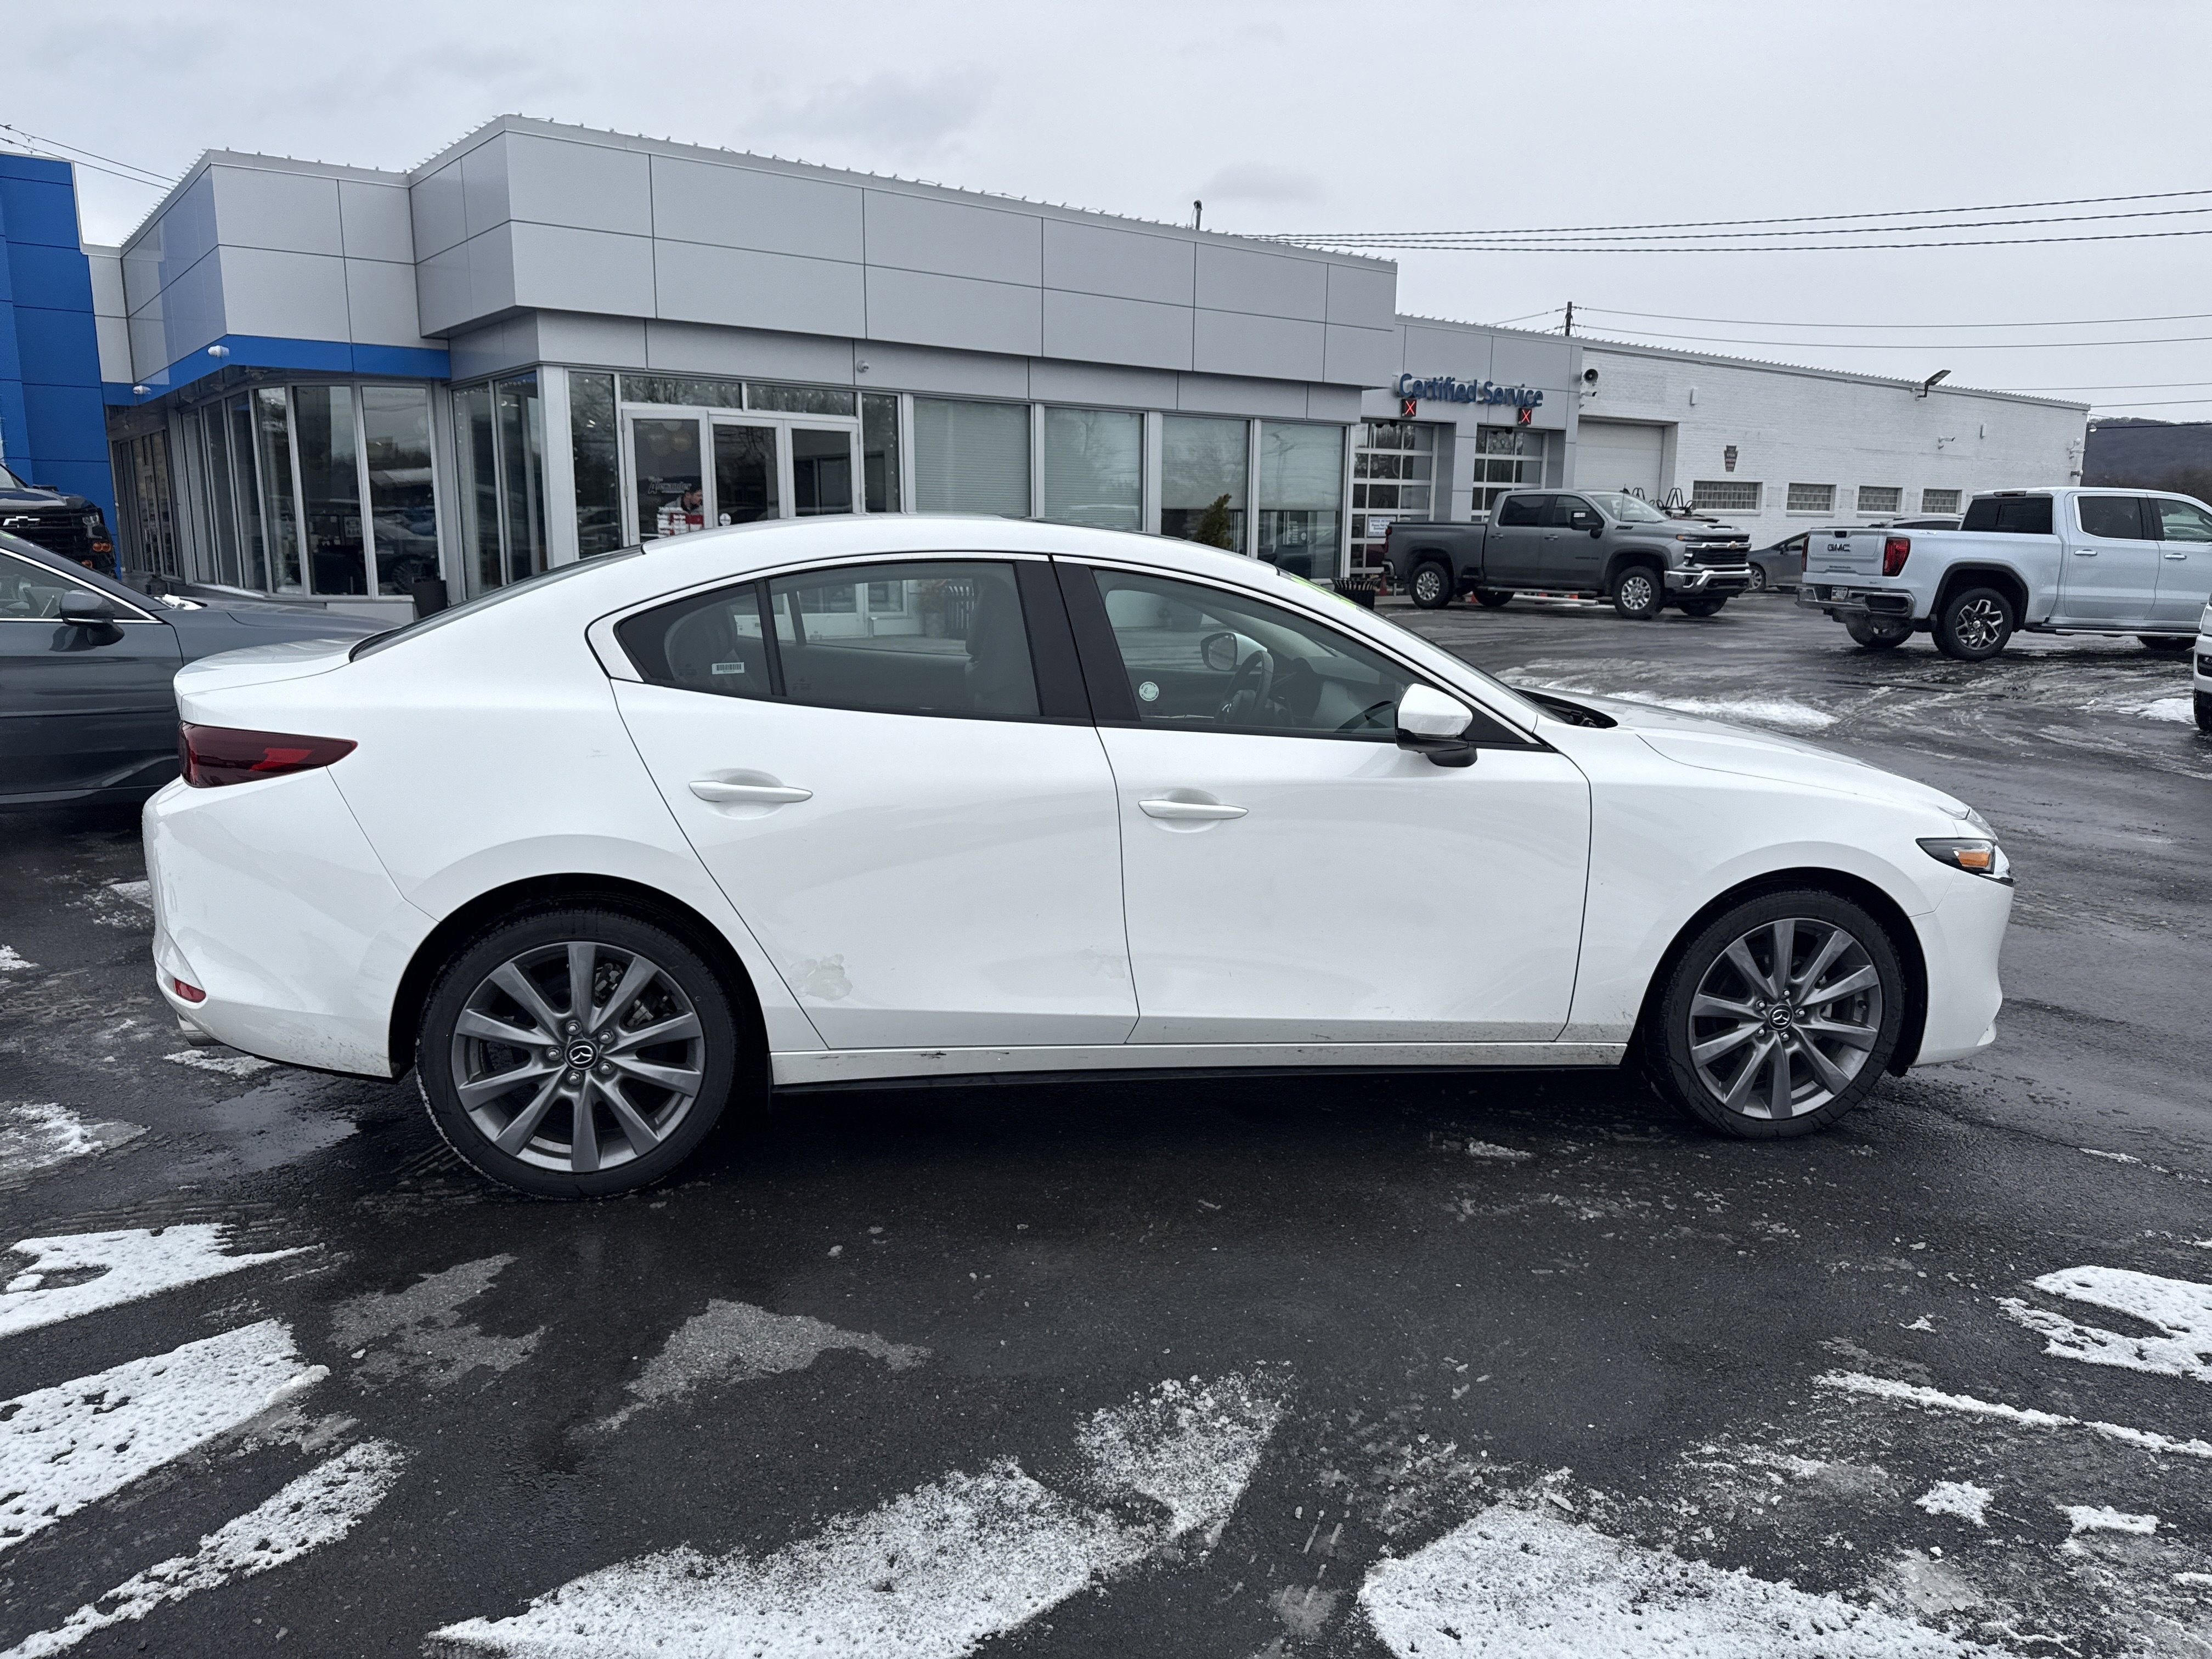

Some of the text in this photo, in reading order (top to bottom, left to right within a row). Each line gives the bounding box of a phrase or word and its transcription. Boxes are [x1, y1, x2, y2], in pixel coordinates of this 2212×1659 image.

[1400, 373, 1543, 407] Certified Service
[1827, 544, 1850, 552] GMC
